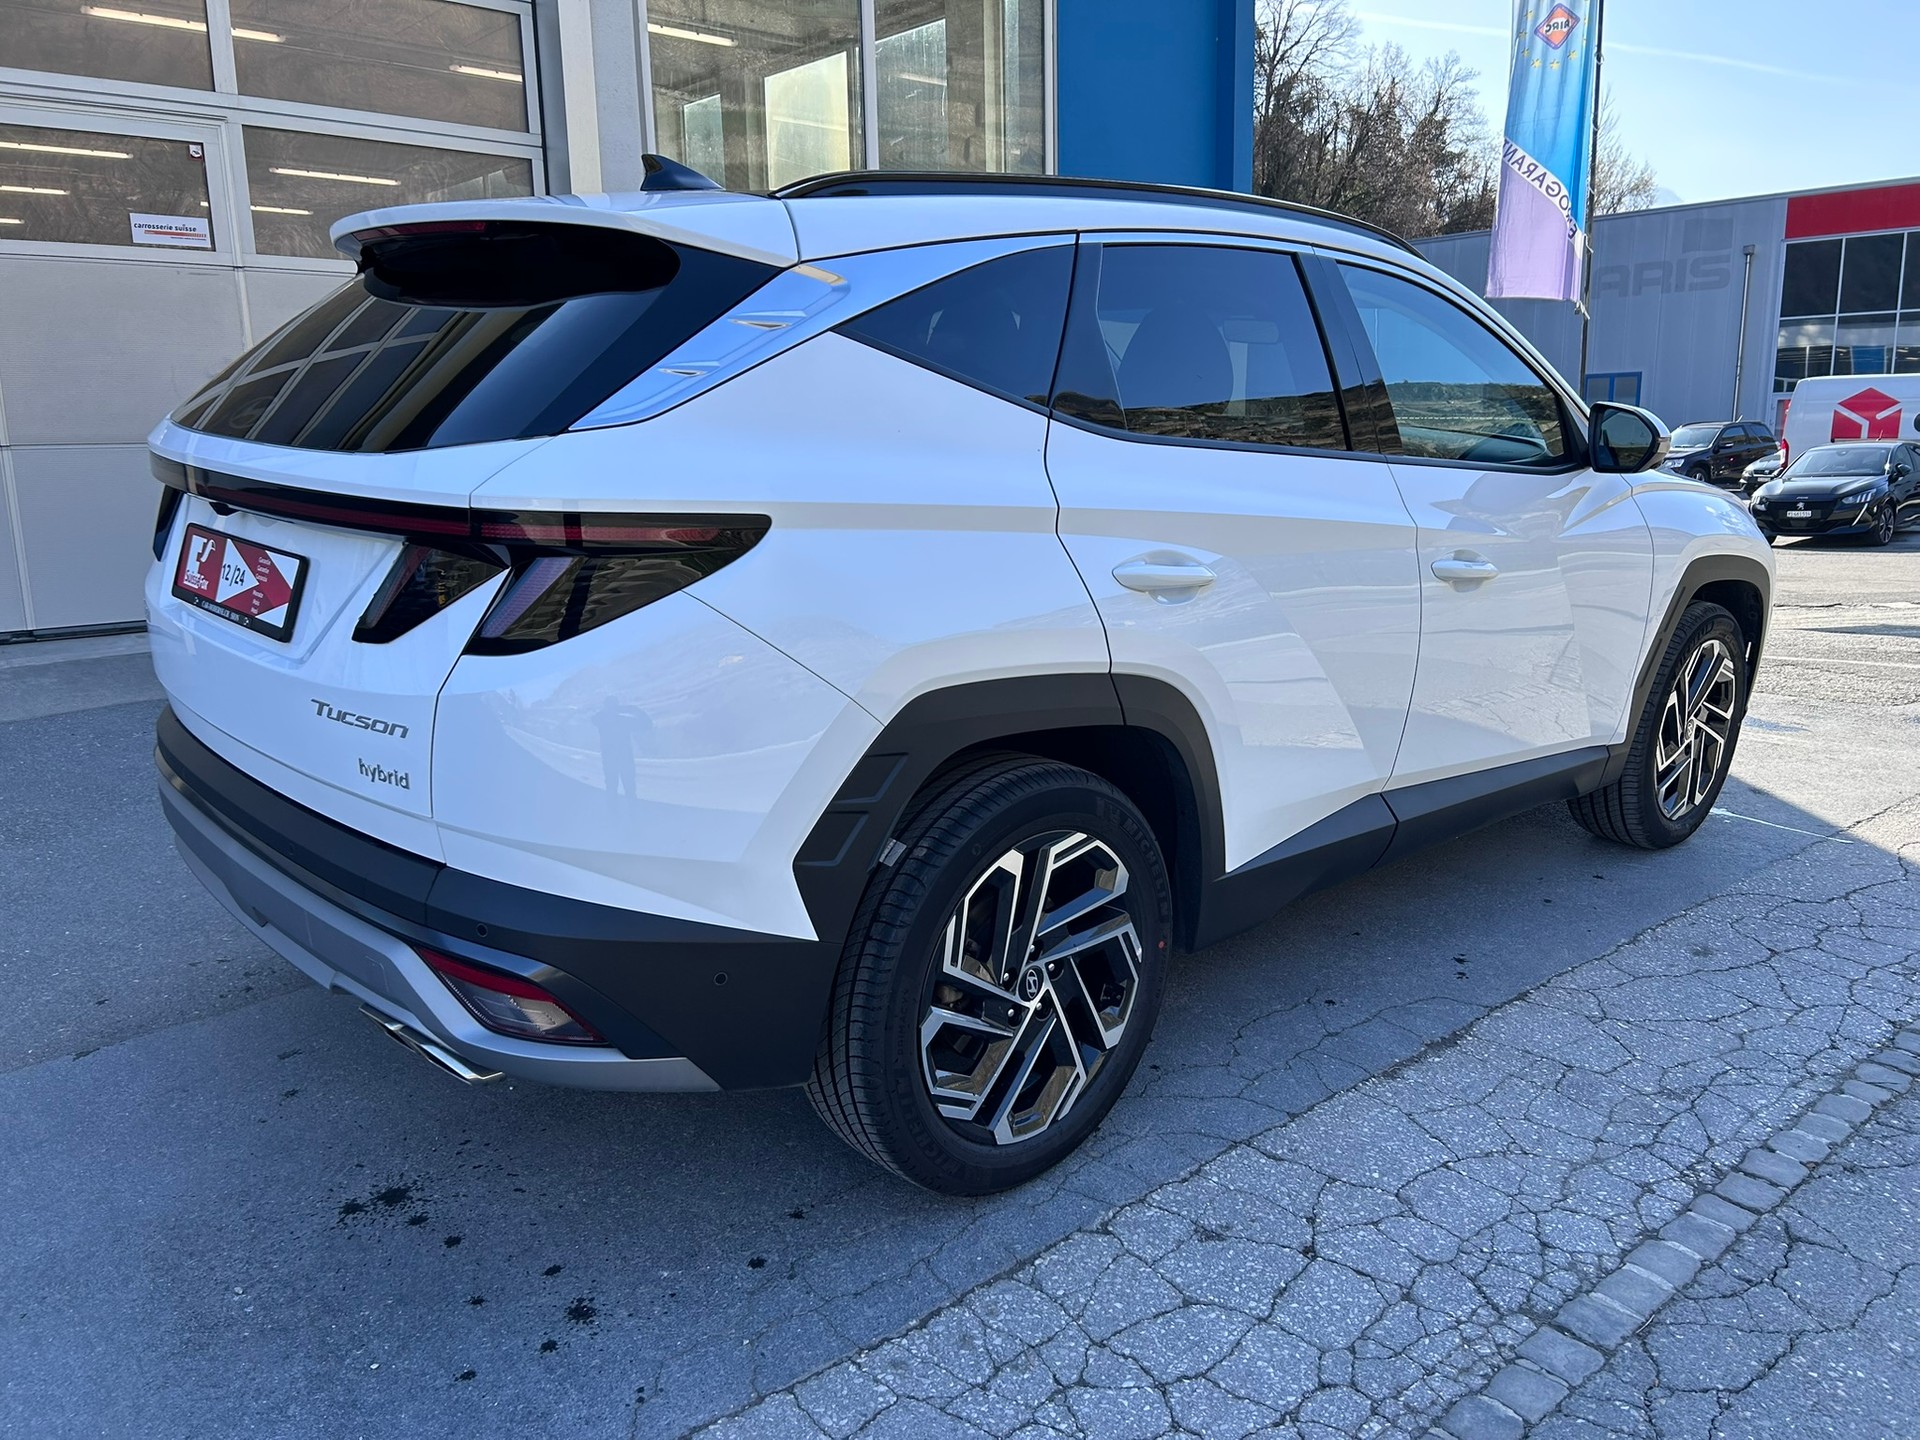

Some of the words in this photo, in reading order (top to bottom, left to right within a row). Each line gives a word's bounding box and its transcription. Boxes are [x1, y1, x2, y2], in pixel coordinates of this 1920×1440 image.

[134, 222, 173, 231] carrosserie
[222, 563, 246, 586] 12/24
[358, 757, 410, 790] hybrid
[1121, 815, 1170, 924] MICHELIN
